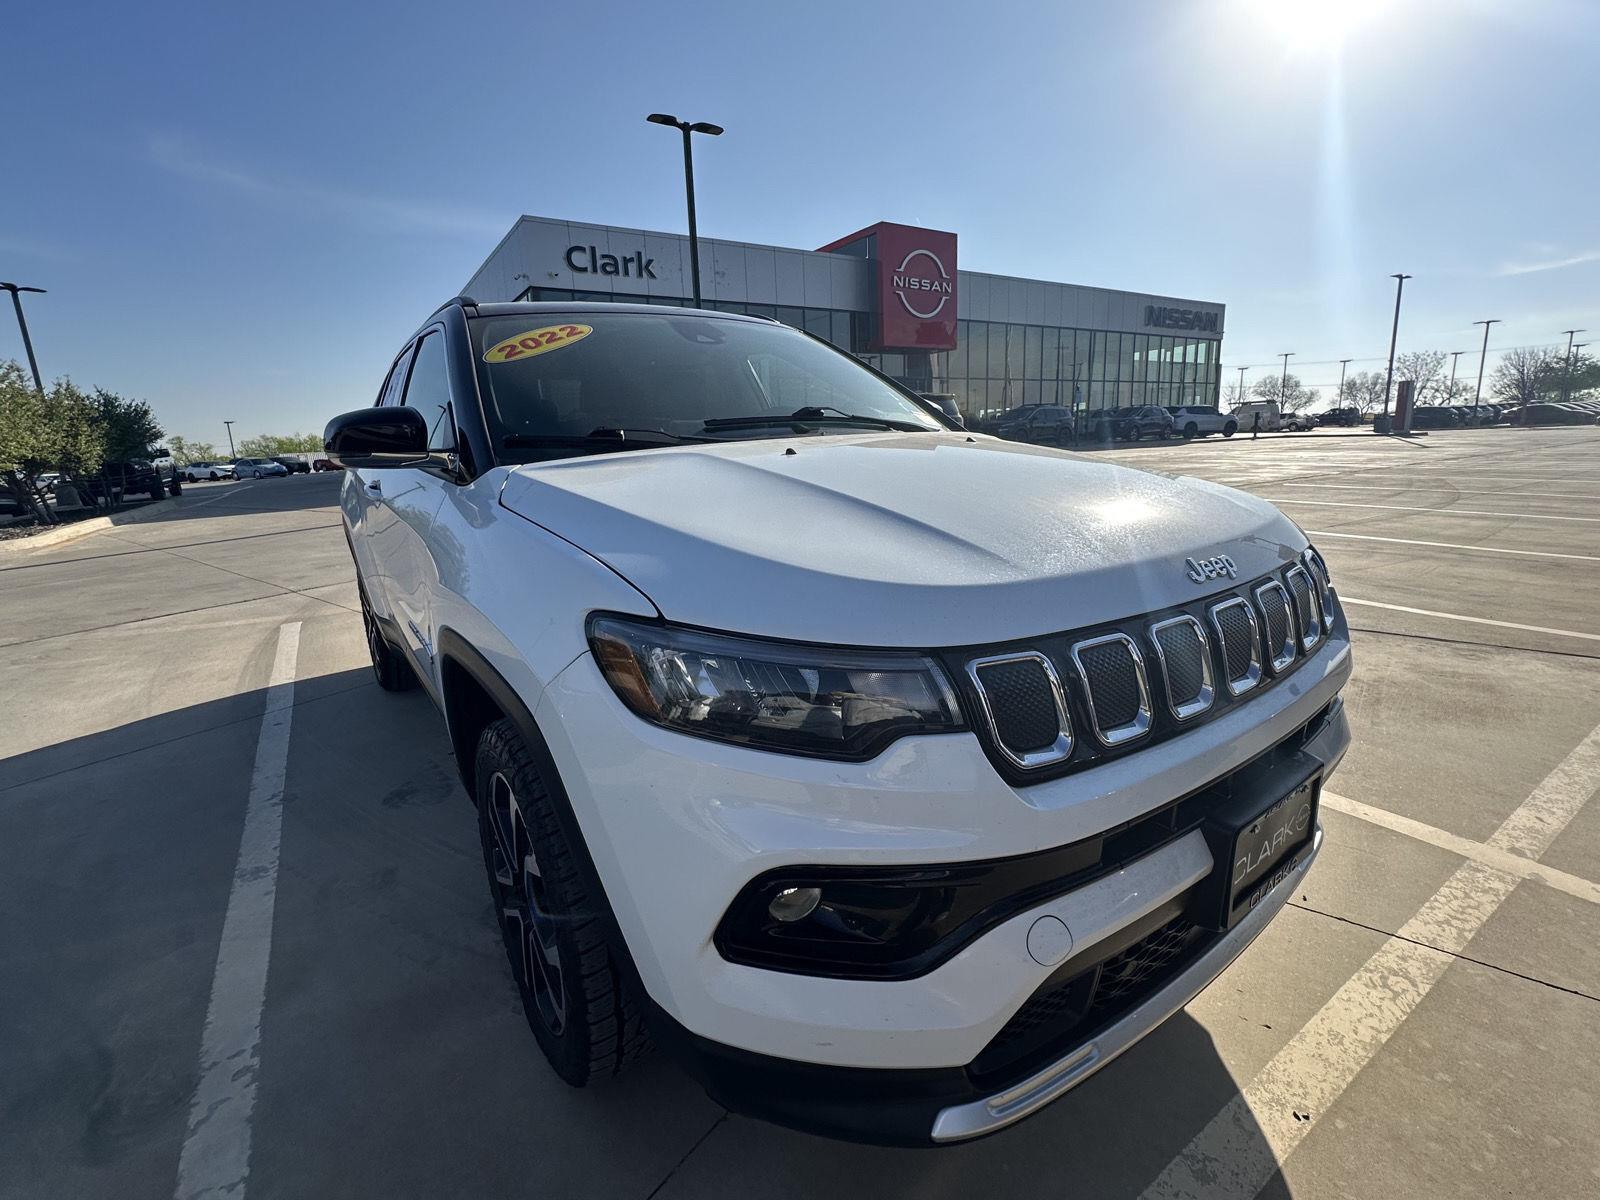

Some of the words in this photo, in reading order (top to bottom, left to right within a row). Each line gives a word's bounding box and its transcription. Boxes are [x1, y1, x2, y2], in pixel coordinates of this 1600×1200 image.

[566, 245, 657, 279] Clark
[893, 275, 952, 293] NISSAN
[1145, 305, 1218, 331] NISSAN
[497, 325, 584, 359] 2022
[1186, 554, 1237, 584] Jeep
[1234, 815, 1295, 885] CLARK
